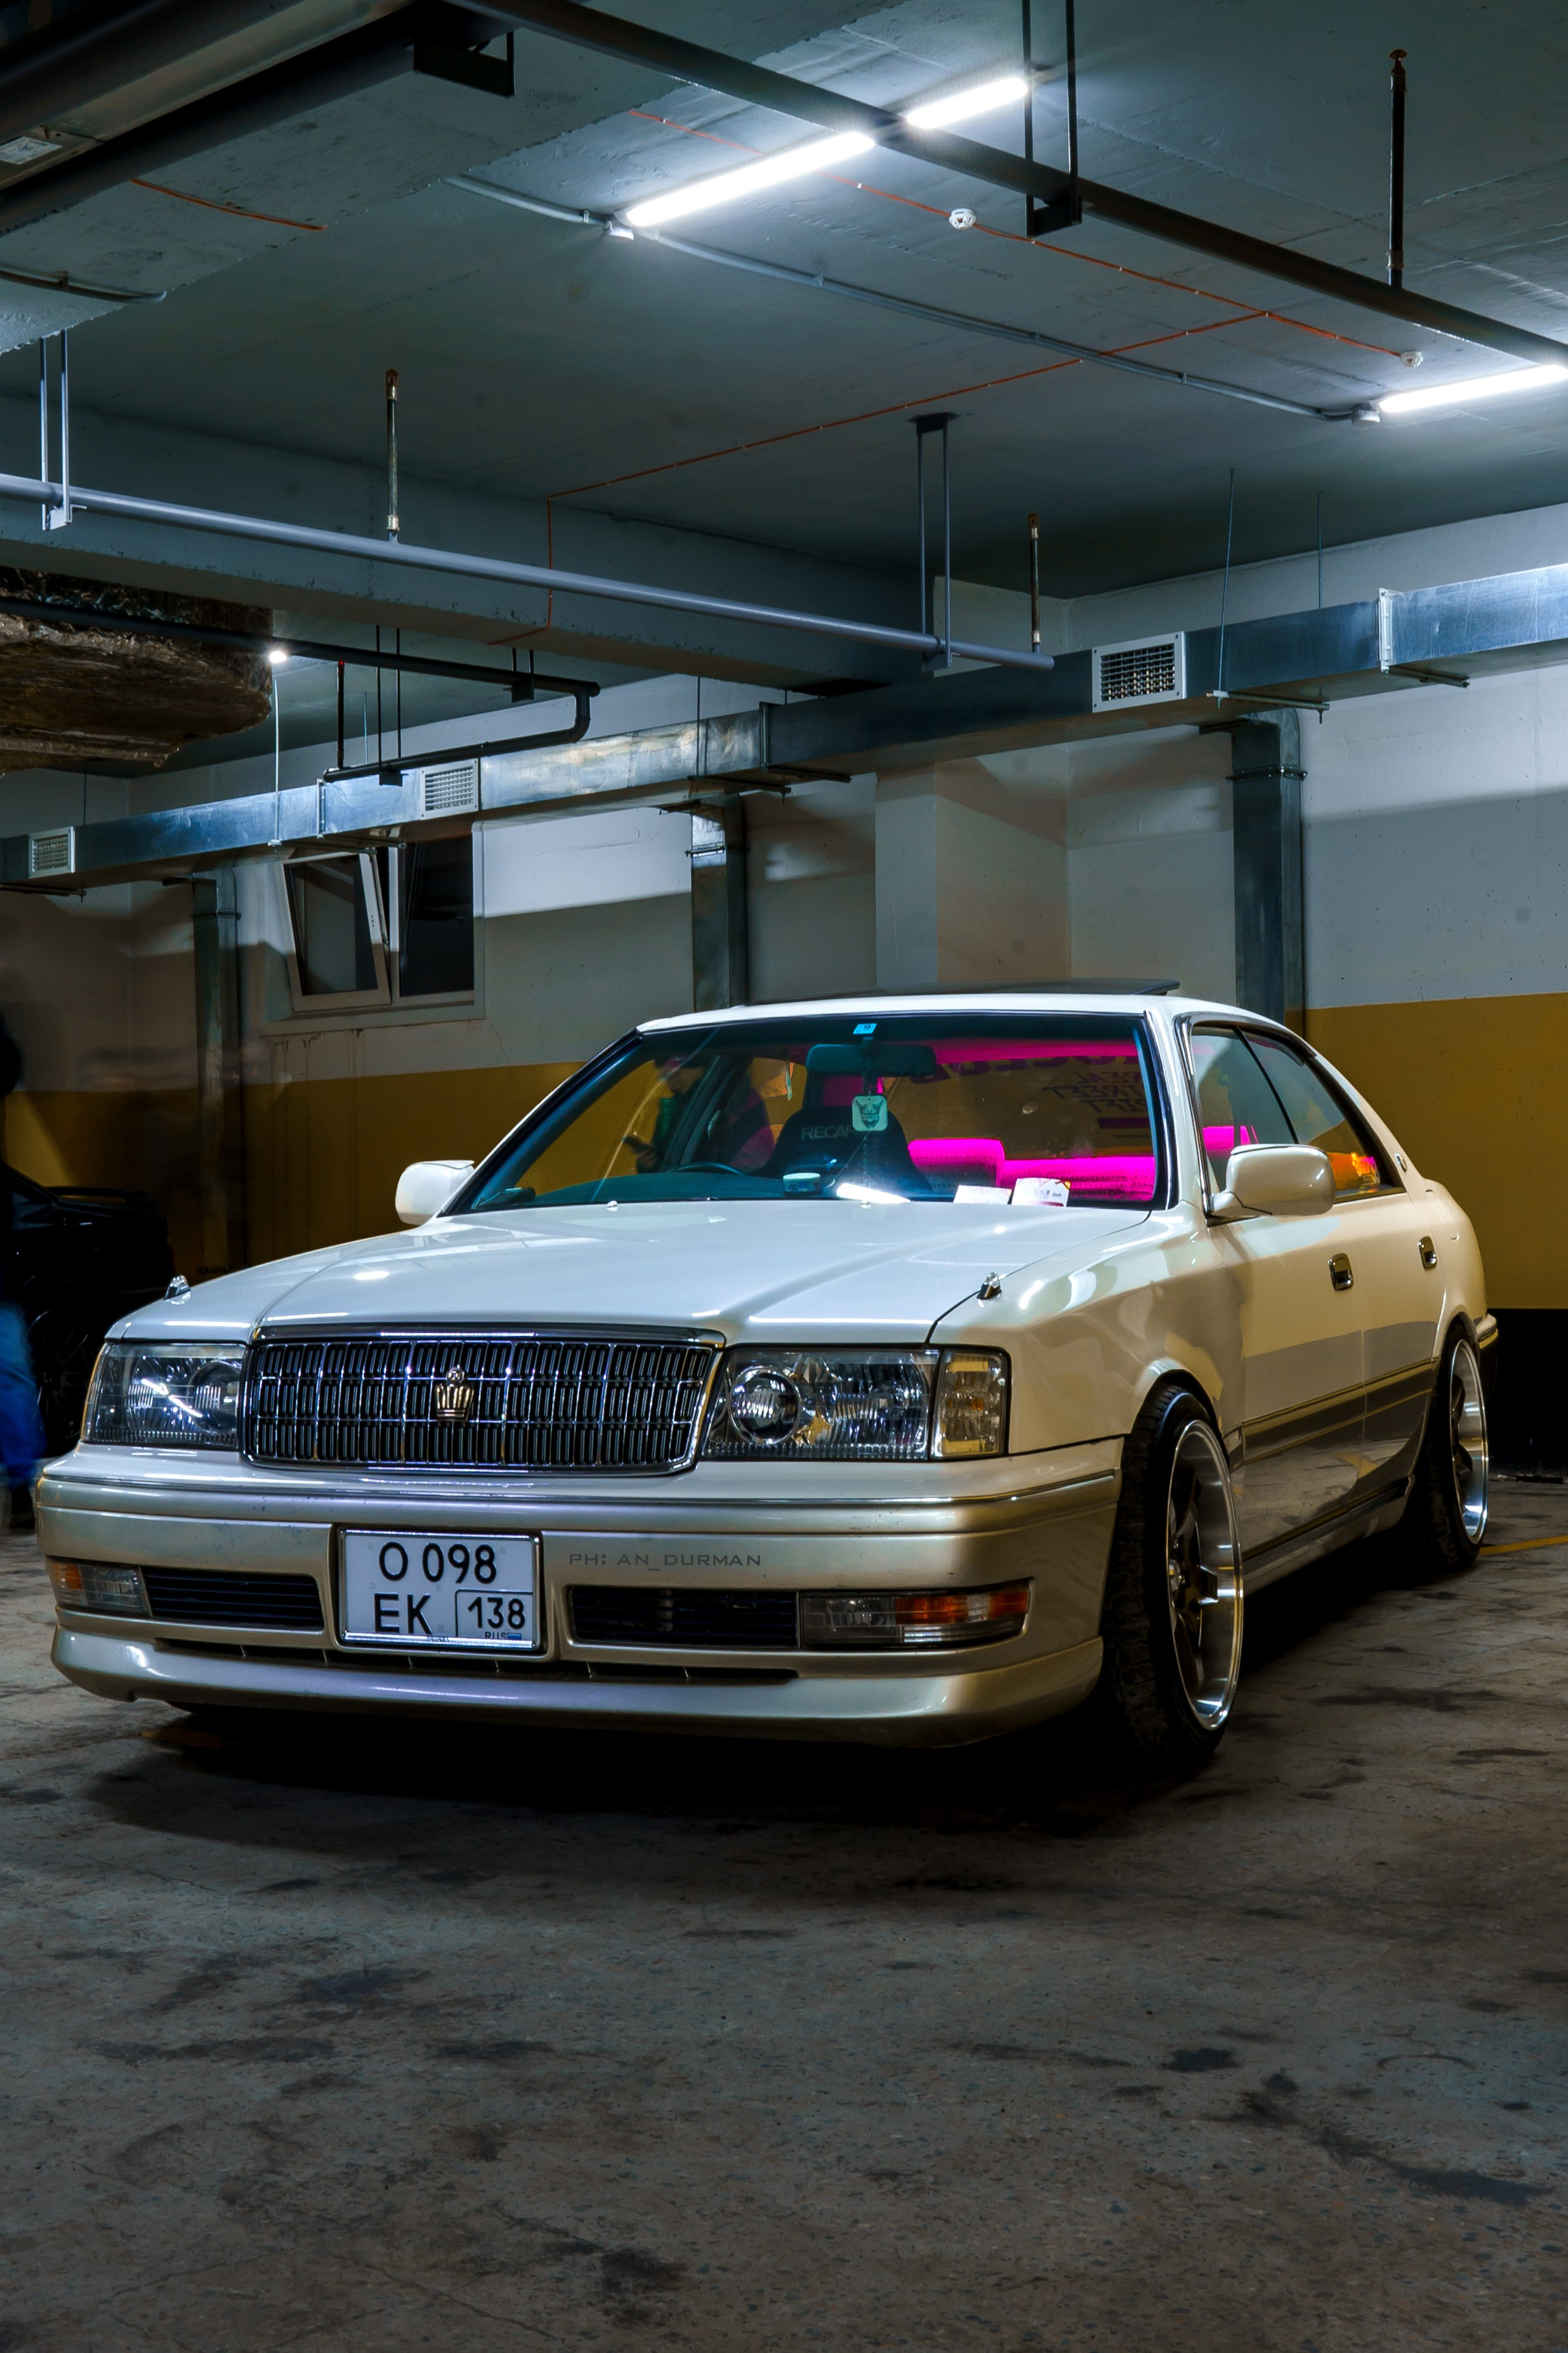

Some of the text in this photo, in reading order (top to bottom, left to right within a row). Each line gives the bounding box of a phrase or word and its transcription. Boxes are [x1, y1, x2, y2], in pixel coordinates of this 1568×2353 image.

[379, 1541, 497, 1584] O 098
[374, 1593, 433, 1634] EK
[468, 1596, 525, 1630] 138
[485, 1631, 507, 1640] RUS
